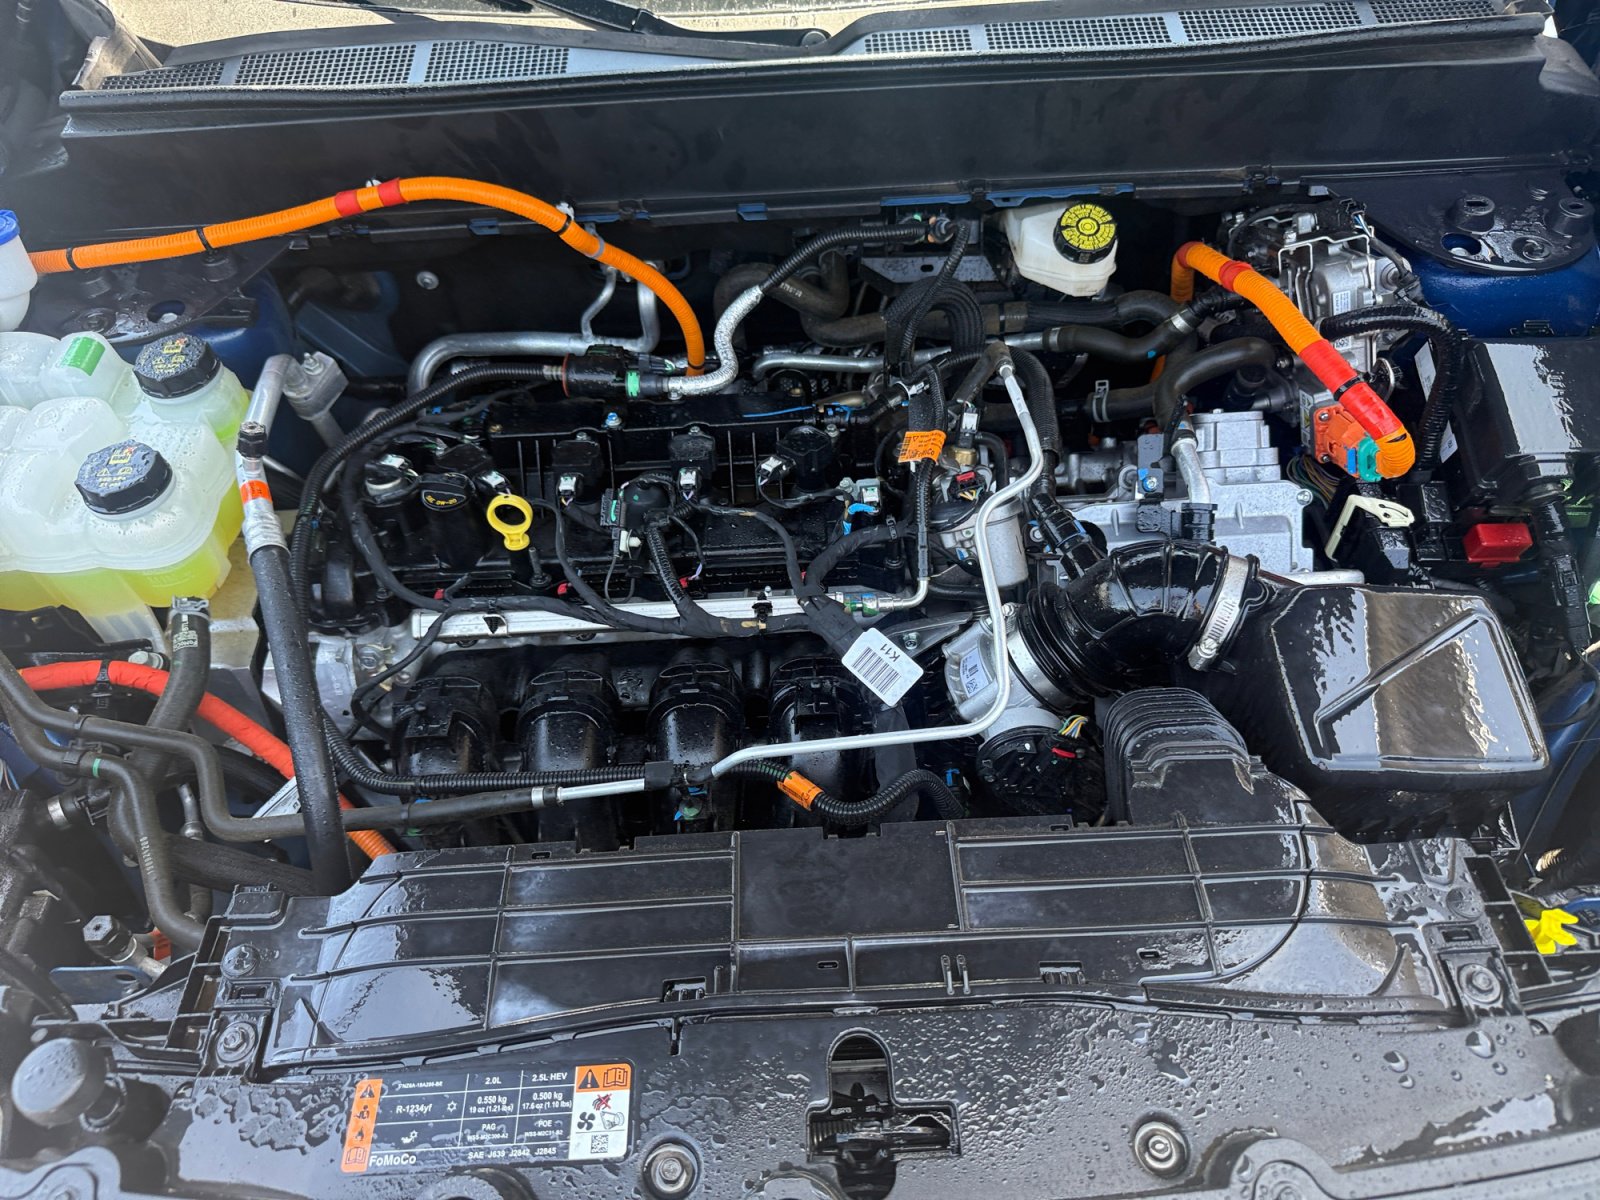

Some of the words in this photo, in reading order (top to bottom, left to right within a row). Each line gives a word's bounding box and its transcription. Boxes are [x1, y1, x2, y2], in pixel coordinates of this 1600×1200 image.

[880, 643, 900, 662] K11
[485, 1077, 502, 1085] 2.0L
[532, 1074, 548, 1082] 2.5L
[550, 1072, 568, 1081] HEV
[477, 1096, 496, 1105] 0.550
[498, 1095, 508, 1104] kg
[532, 1092, 552, 1101] 0.500
[554, 1091, 563, 1101] kg
[396, 1104, 433, 1114] R-1234yf
[469, 1106, 477, 1114] 19
[482, 1123, 496, 1131] PAG
[537, 1120, 552, 1128] POE
[467, 1151, 485, 1160] SAE
[487, 1150, 506, 1158] J639
[534, 1146, 557, 1155] J2845
[369, 1153, 417, 1167] FoMoCo
